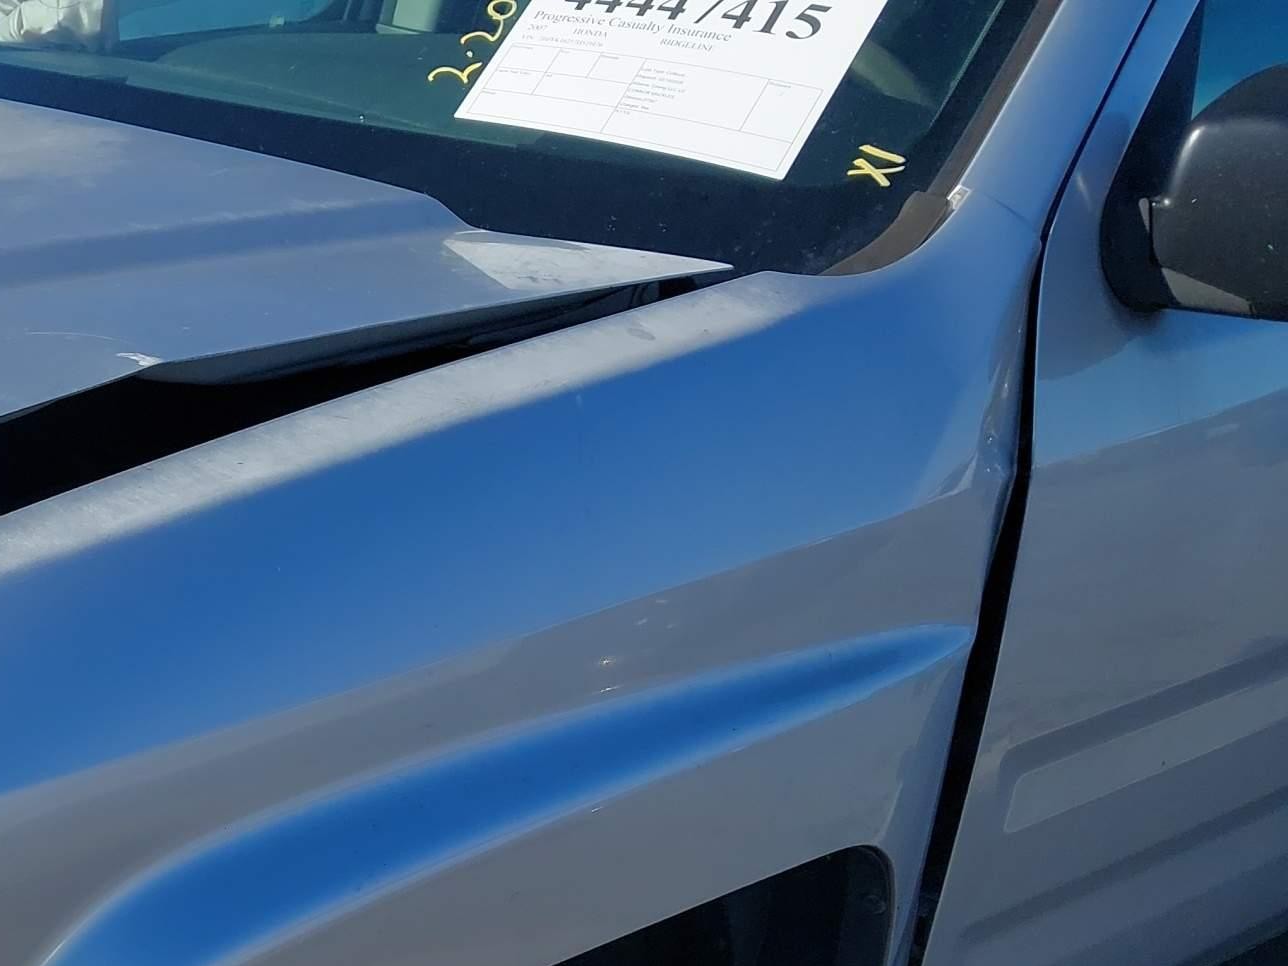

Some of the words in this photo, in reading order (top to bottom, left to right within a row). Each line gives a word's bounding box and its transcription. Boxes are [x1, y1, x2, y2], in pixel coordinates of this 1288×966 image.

[533, 9, 608, 26] Progressive
[608, 17, 664, 34] Casualty
[667, 23, 733, 42] Insurance
[573, 28, 608, 39] HONDA
[659, 38, 714, 52] RIDGELINE
